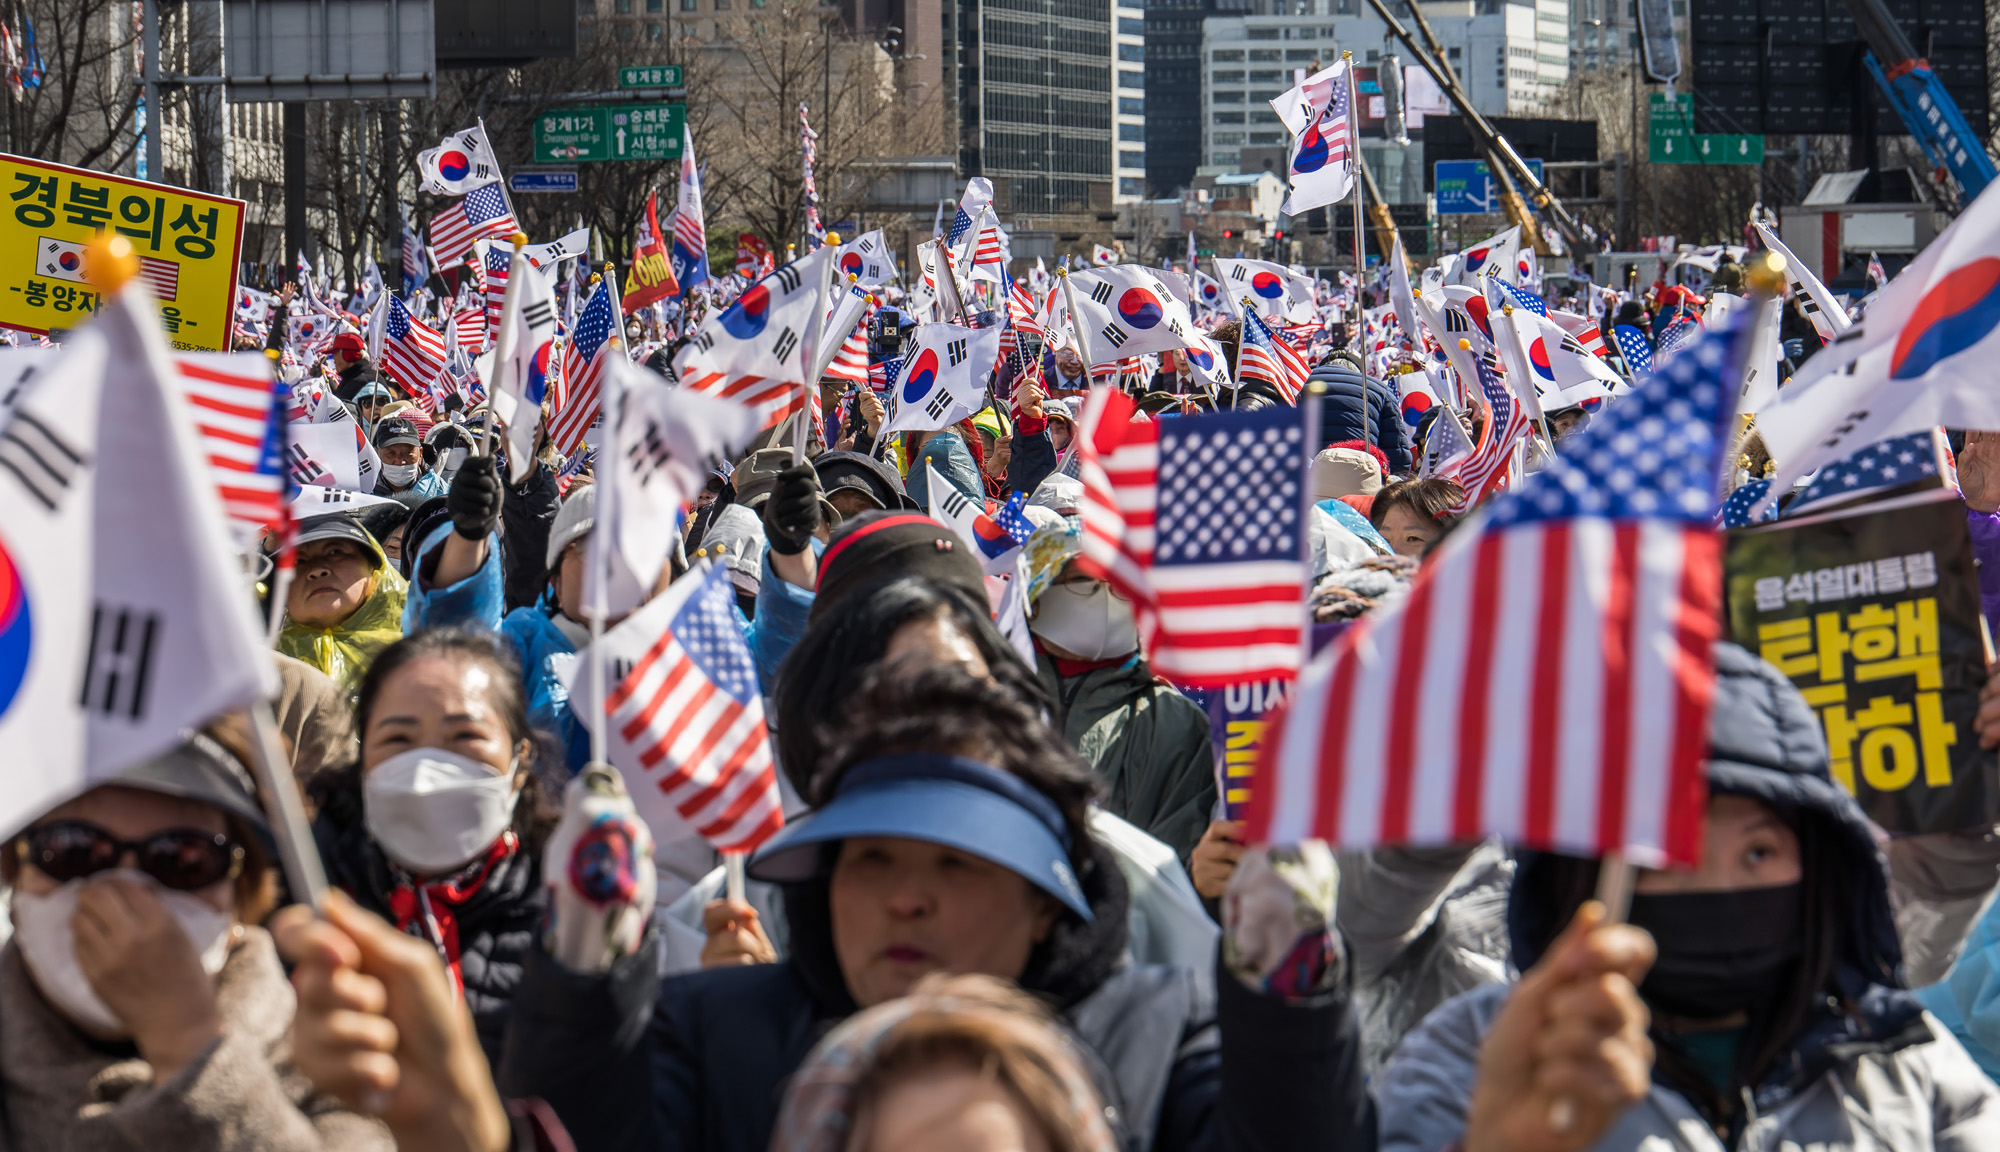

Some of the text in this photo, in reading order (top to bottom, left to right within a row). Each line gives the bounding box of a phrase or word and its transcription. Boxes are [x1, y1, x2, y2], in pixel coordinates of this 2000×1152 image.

[626, 69, 675, 84] 청계광장
[542, 116, 595, 132] 청계1가
[629, 108, 671, 123] 숭례문
[631, 135, 657, 150] 시청
[9, 172, 219, 260] 경북의성
[10, 280, 198, 334] -봉양자을-
[1754, 550, 1939, 612] 윤석열대통령
[1757, 597, 1943, 692] 탄핵
